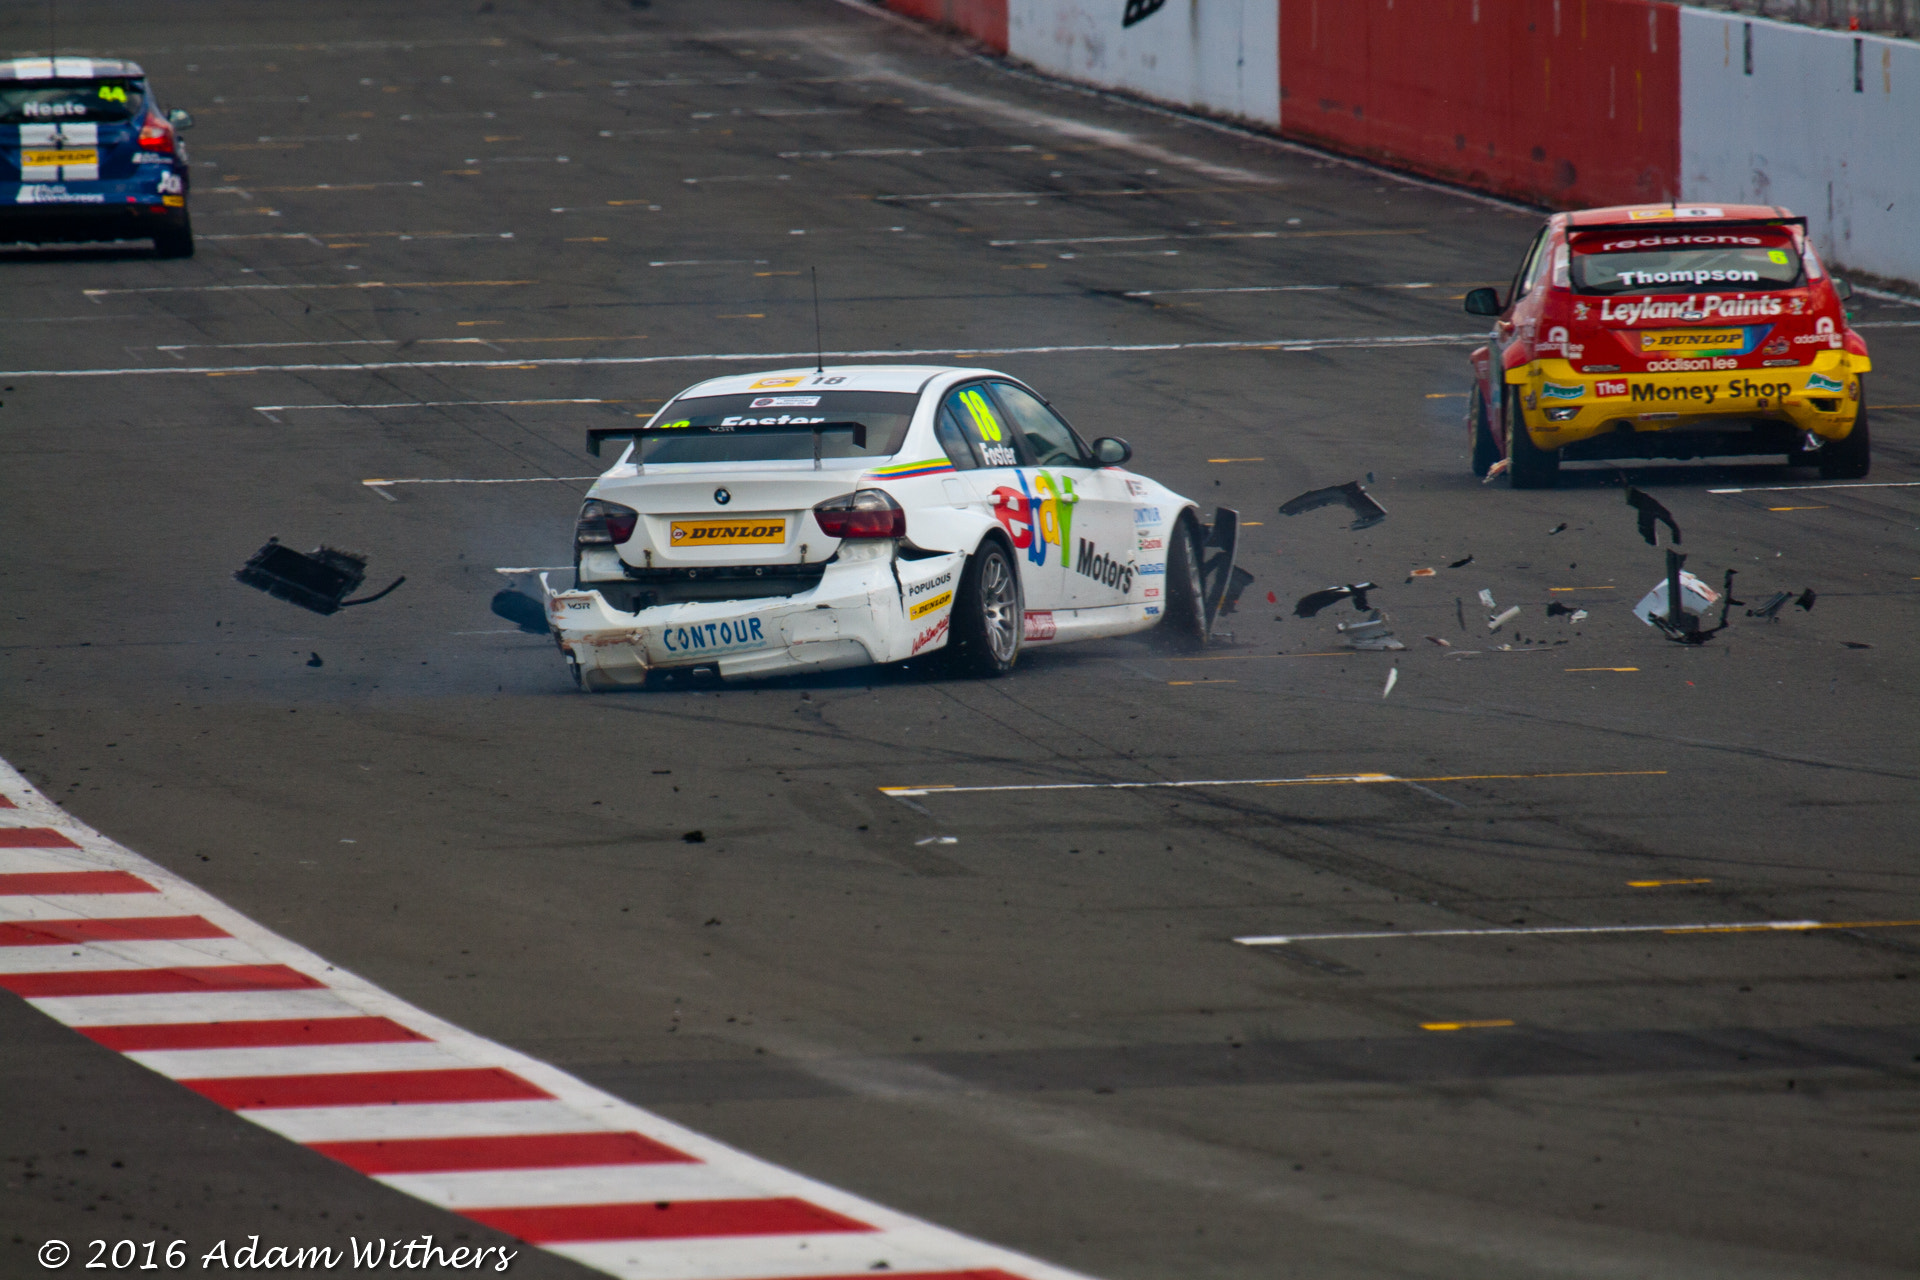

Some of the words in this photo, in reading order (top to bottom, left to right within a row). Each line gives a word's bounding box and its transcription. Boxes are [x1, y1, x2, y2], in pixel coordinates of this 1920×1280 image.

[98, 86, 127, 102] 44
[23, 101, 86, 116] Neate
[1603, 234, 1762, 251] redstone
[1766, 250, 1789, 265] 6
[1617, 268, 1759, 285] Thompson
[1601, 294, 1697, 326] Leyland
[1702, 293, 1782, 318] Paints
[1658, 333, 1743, 346] DUNLOP
[1646, 357, 1710, 373] addison
[1712, 356, 1738, 370] lee
[811, 376, 847, 385] 18
[1596, 381, 1626, 395] The
[1632, 382, 1719, 404] Money
[1729, 377, 1791, 401] Shop
[959, 390, 1002, 442] 18
[978, 442, 1017, 466] Foster
[689, 525, 784, 539] DUNLOP
[1076, 537, 1134, 594] Motors
[908, 572, 952, 597] POPULOUS
[918, 594, 951, 614] DUNLOP
[663, 617, 764, 651] CONTOUR
